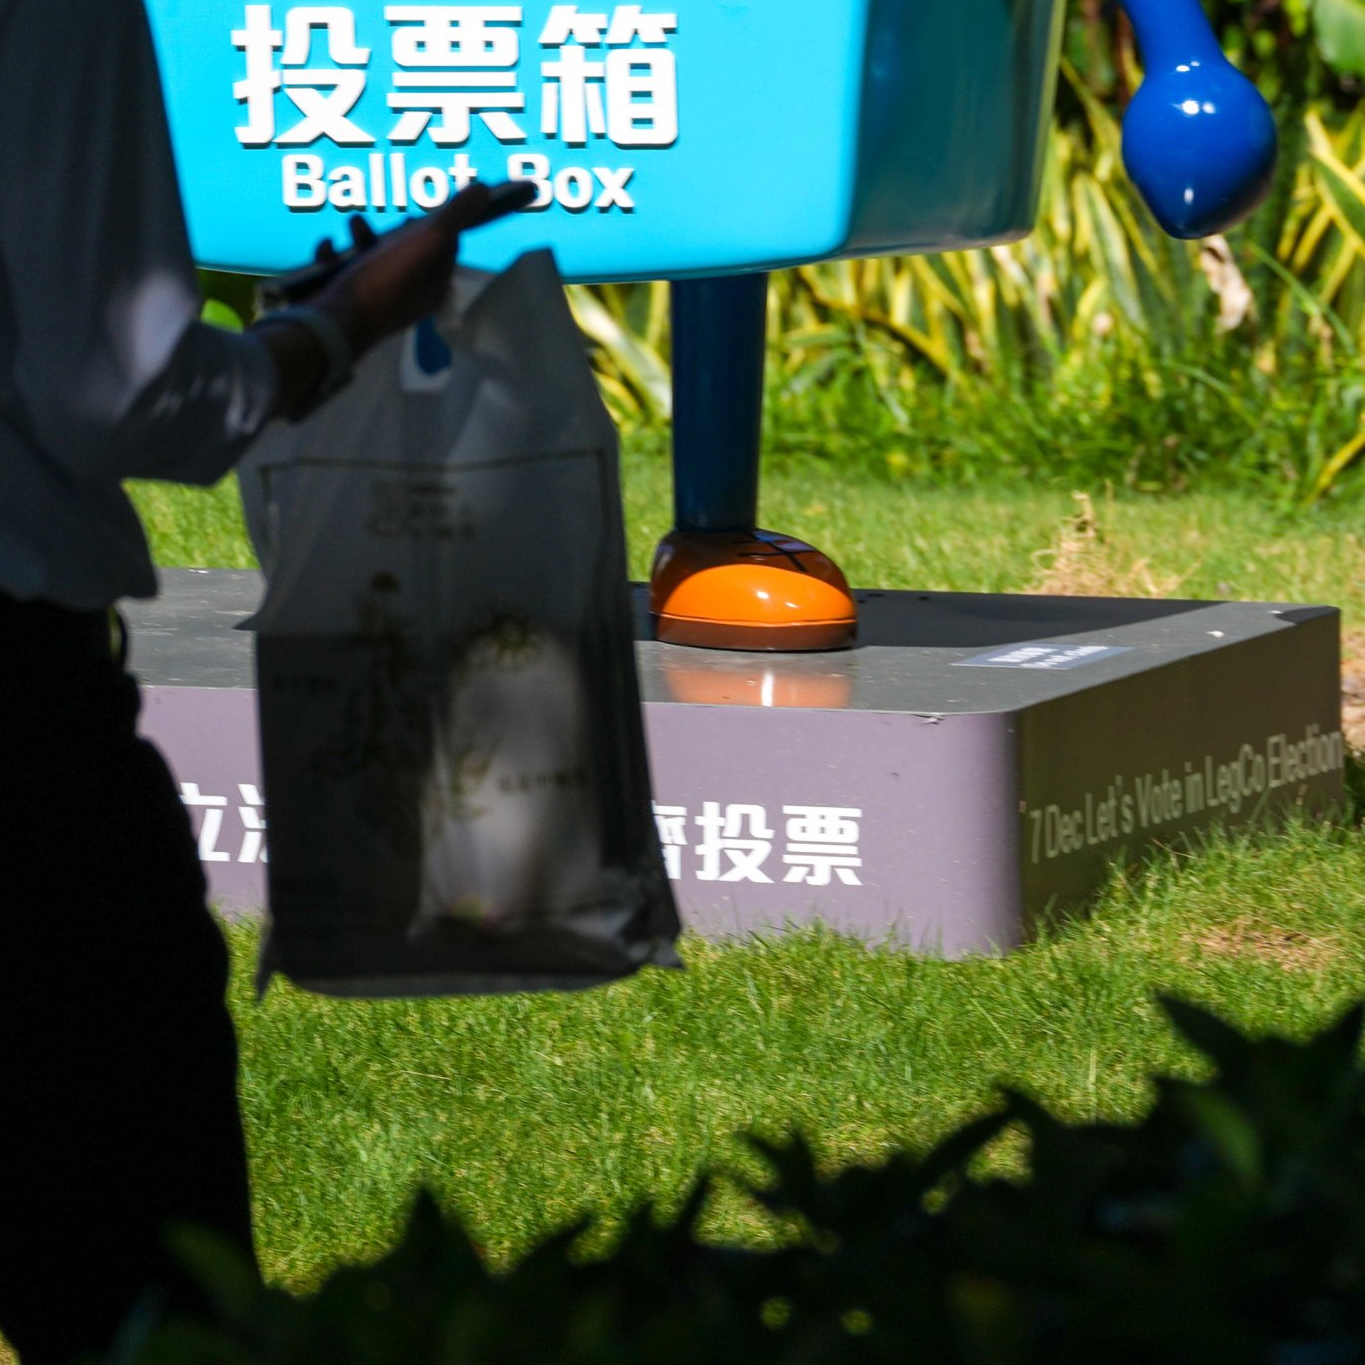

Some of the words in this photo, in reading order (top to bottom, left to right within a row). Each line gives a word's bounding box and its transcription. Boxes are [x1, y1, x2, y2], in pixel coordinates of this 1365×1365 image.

[231, 4, 679, 145] 投票箱
[282, 153, 478, 209] Ballot
[507, 153, 635, 209] Box
[1029, 808, 1043, 864] 7
[1045, 804, 1083, 858] Dec
[1135, 768, 1183, 828] Vote
[1184, 761, 1205, 814] in
[1205, 743, 1267, 814] LegCo
[1268, 723, 1345, 789] Election
